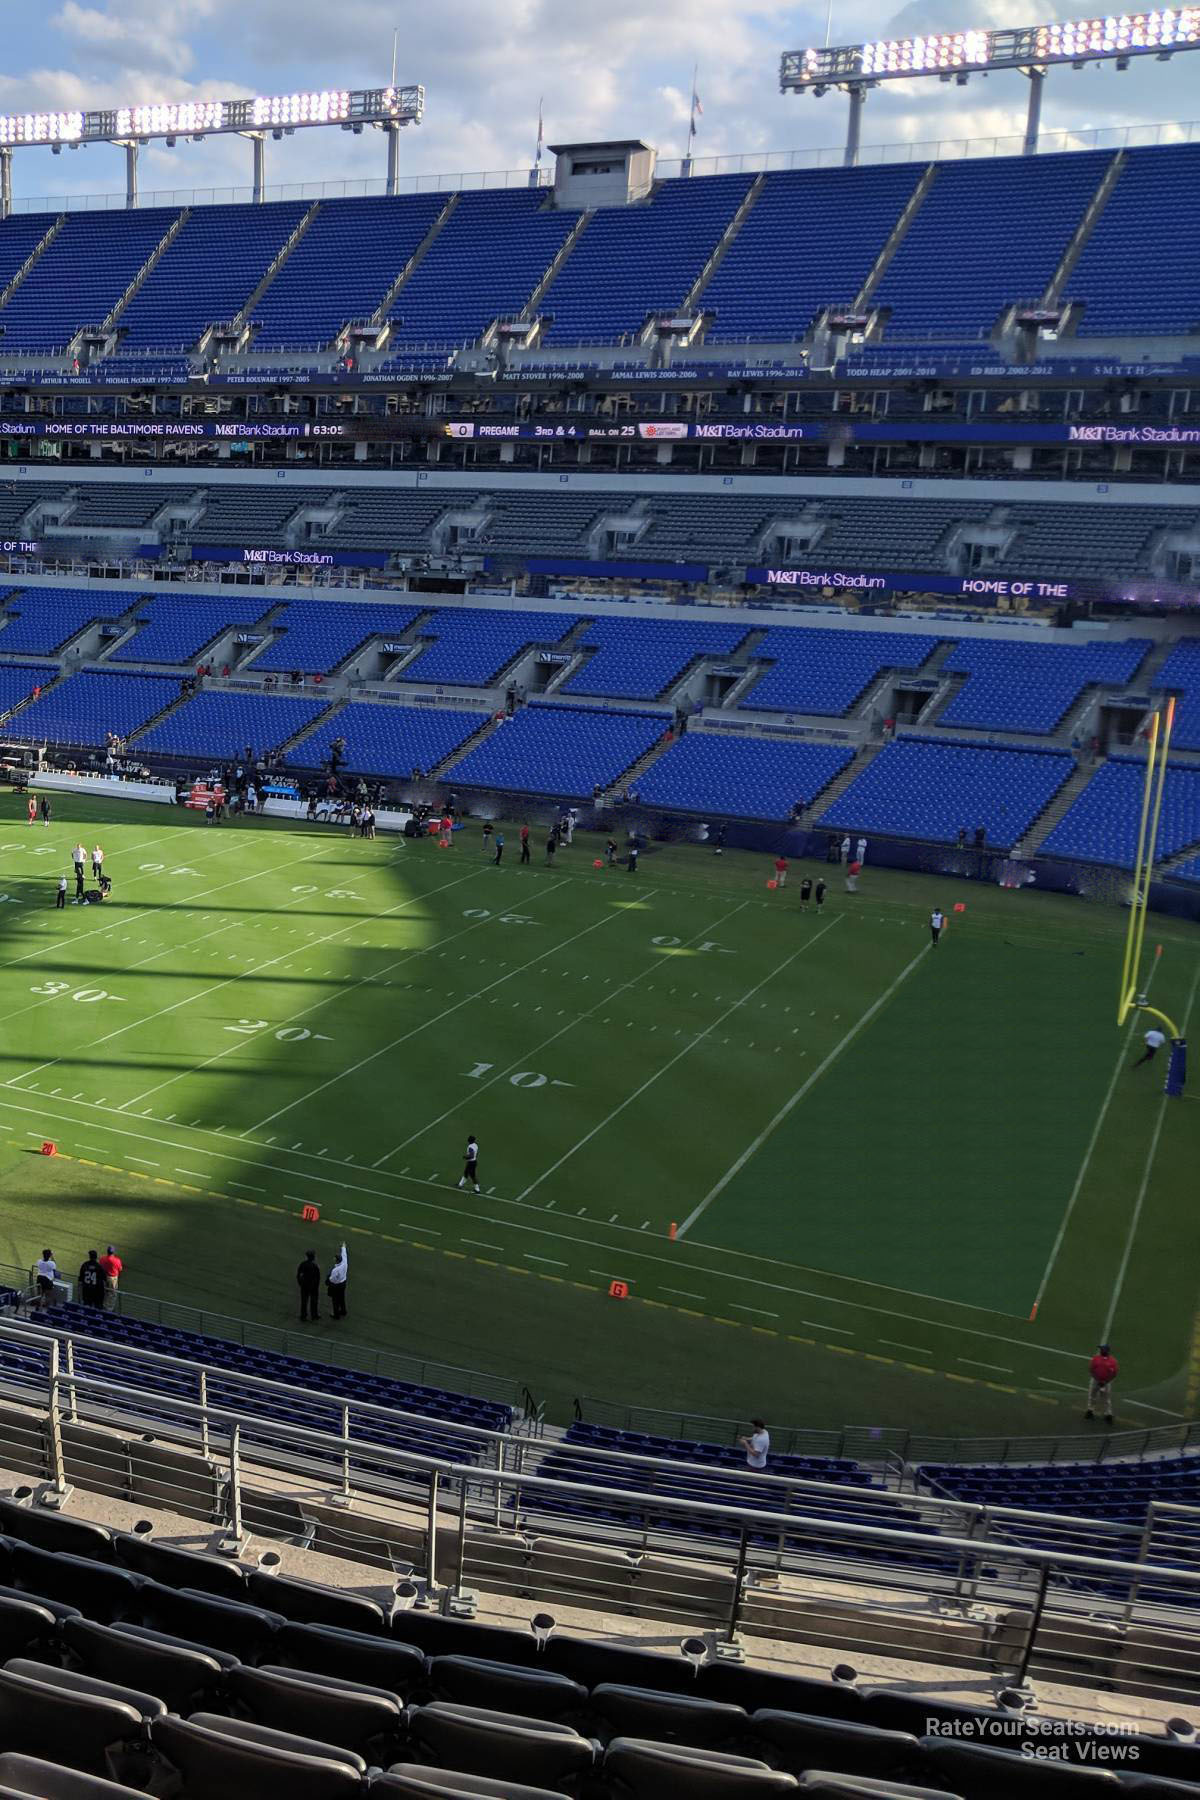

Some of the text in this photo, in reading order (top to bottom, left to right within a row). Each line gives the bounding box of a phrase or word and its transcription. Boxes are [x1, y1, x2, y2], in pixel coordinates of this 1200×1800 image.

[659, 370, 698, 378] 2000-2006
[728, 370, 741, 378] RAY
[892, 368, 936, 376] 2001-2010
[420, 374, 453, 382] 1996-2007
[2, 423, 36, 434] Stadium
[46, 424, 204, 435] HOME OF THE BALTIMORE RAVENS
[216, 425, 299, 436] M&T Bank Stadium
[459, 425, 467, 436] 0
[479, 426, 519, 436] PREGAME
[535, 426, 553, 436] 3RD
[556, 426, 565, 436] &
[568, 426, 576, 436] 4
[588, 428, 606, 436] BALL
[621, 426, 635, 436] 25
[696, 425, 802, 438] M&T Bank Stadium
[1069, 426, 1200, 442] M&T Bank Stadium
[4, 540, 18, 551] OF
[244, 550, 333, 564] M&T Bank Stadium
[768, 570, 885, 588] M&T Bank Stadium
[962, 580, 1068, 597] HOME OF THE
[29, 981, 109, 1002] 30
[223, 1018, 312, 1041] 20
[456, 1062, 548, 1088] 10
[306, 1208, 314, 1219] 10
[84, 1272, 96, 1284] 24
[614, 1284, 624, 1296] G
